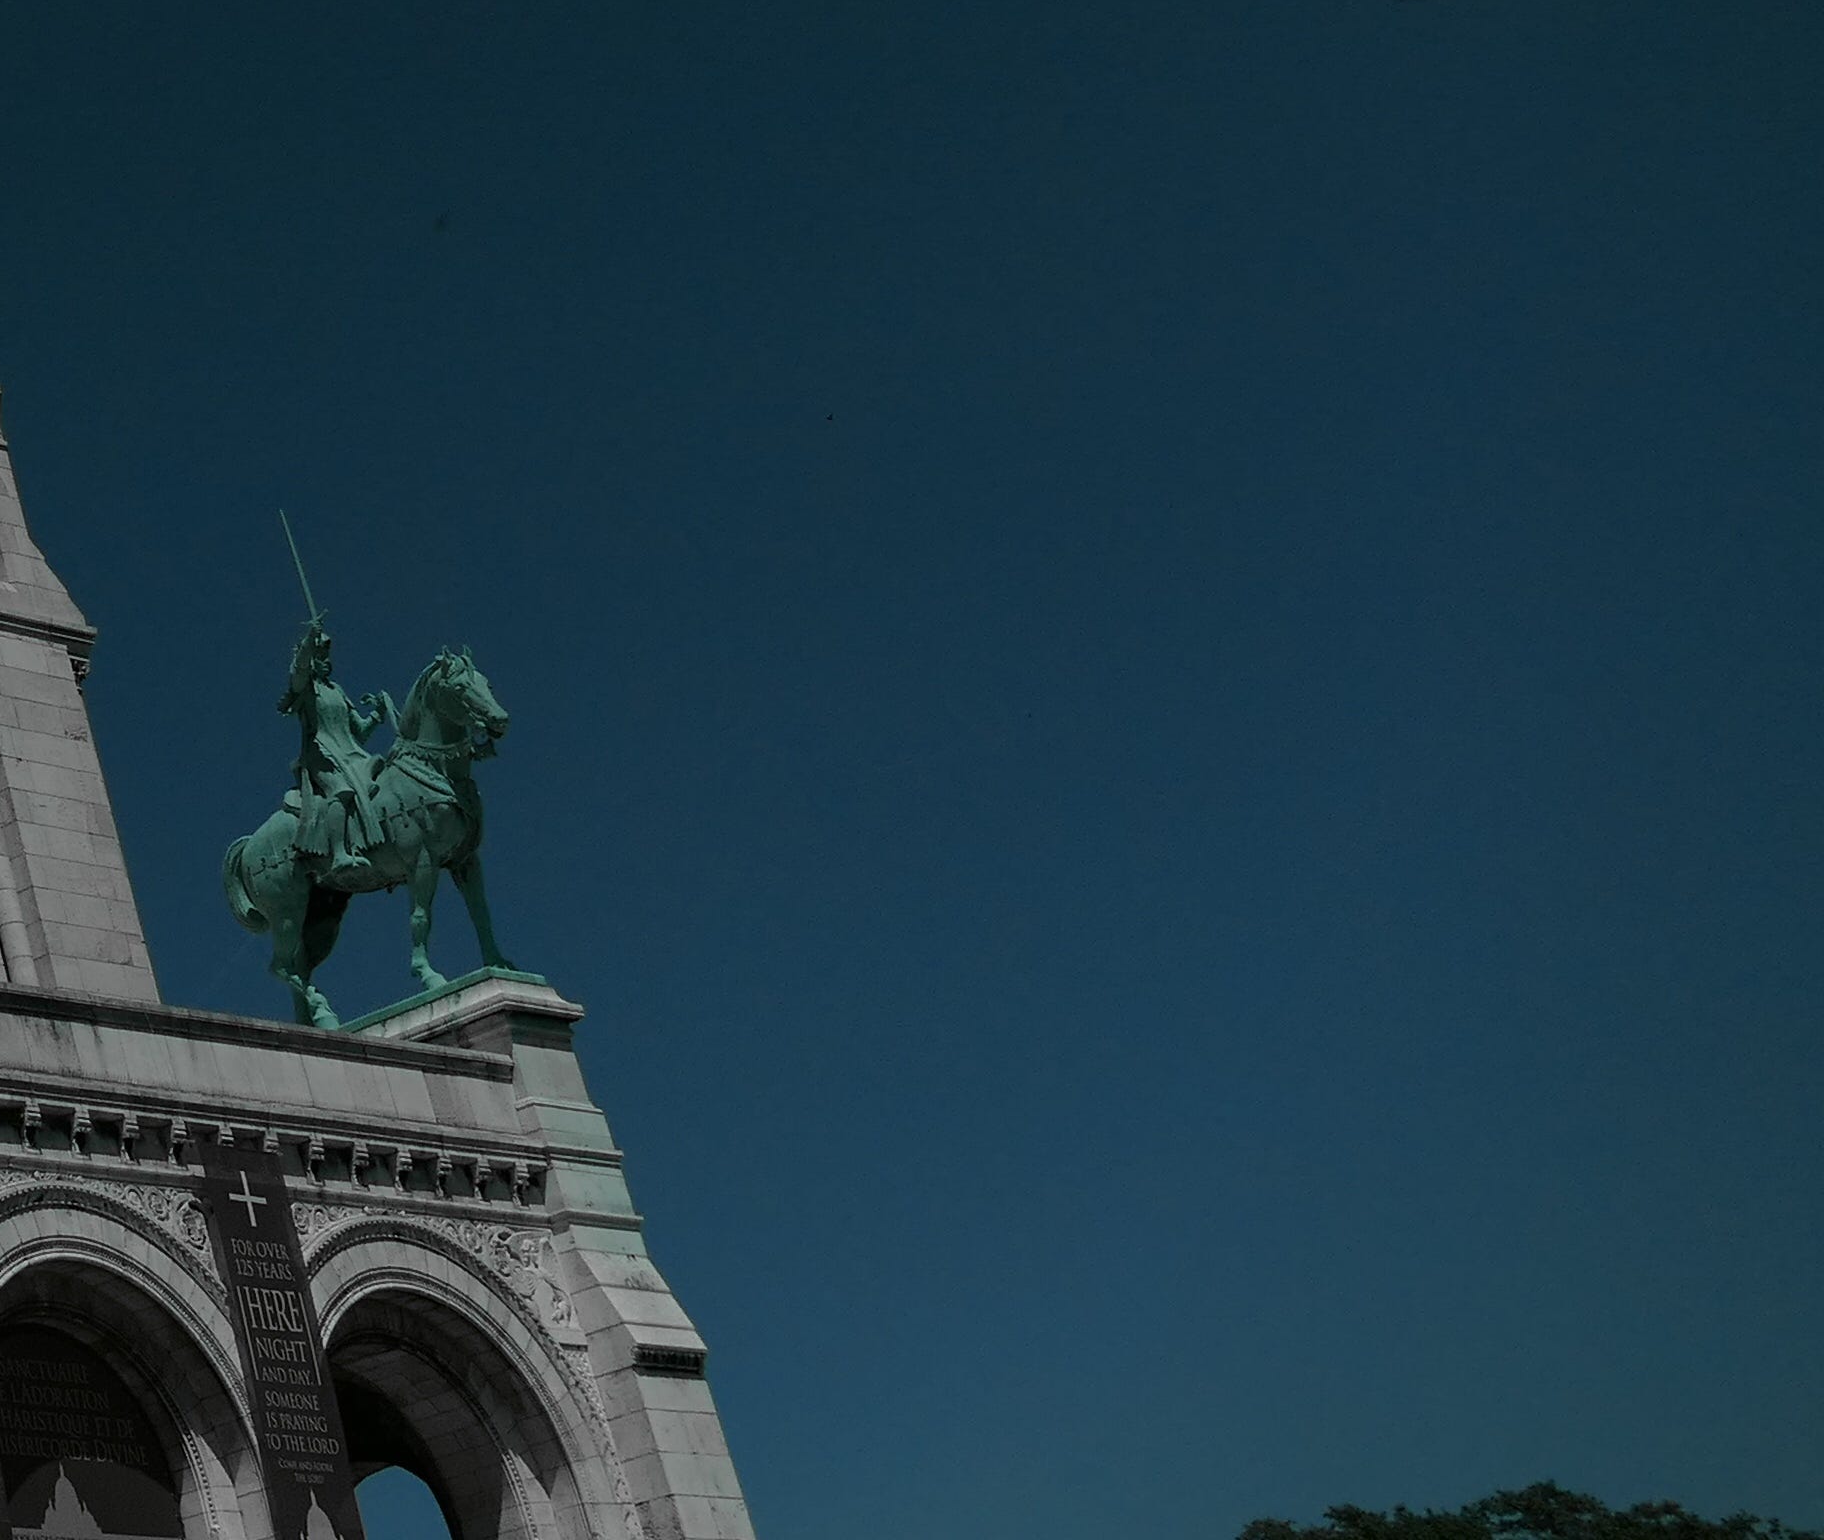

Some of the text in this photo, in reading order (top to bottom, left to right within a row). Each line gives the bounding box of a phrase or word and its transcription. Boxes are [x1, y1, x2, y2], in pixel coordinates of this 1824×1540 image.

[231, 1238, 290, 1261] FOR OVER
[236, 1259, 295, 1281] 125 YEARS.
[243, 1286, 303, 1332] HERE
[256, 1337, 306, 1362] NIGHT
[262, 1367, 314, 1386] AND DAY.
[265, 1390, 320, 1411] SOMEONE
[94, 1416, 110, 1436] ET
[115, 1419, 136, 1439] DE
[265, 1412, 328, 1433] IS PRAYING
[94, 1439, 149, 1466] DIVINE
[265, 1433, 340, 1455] TO THE LORD
